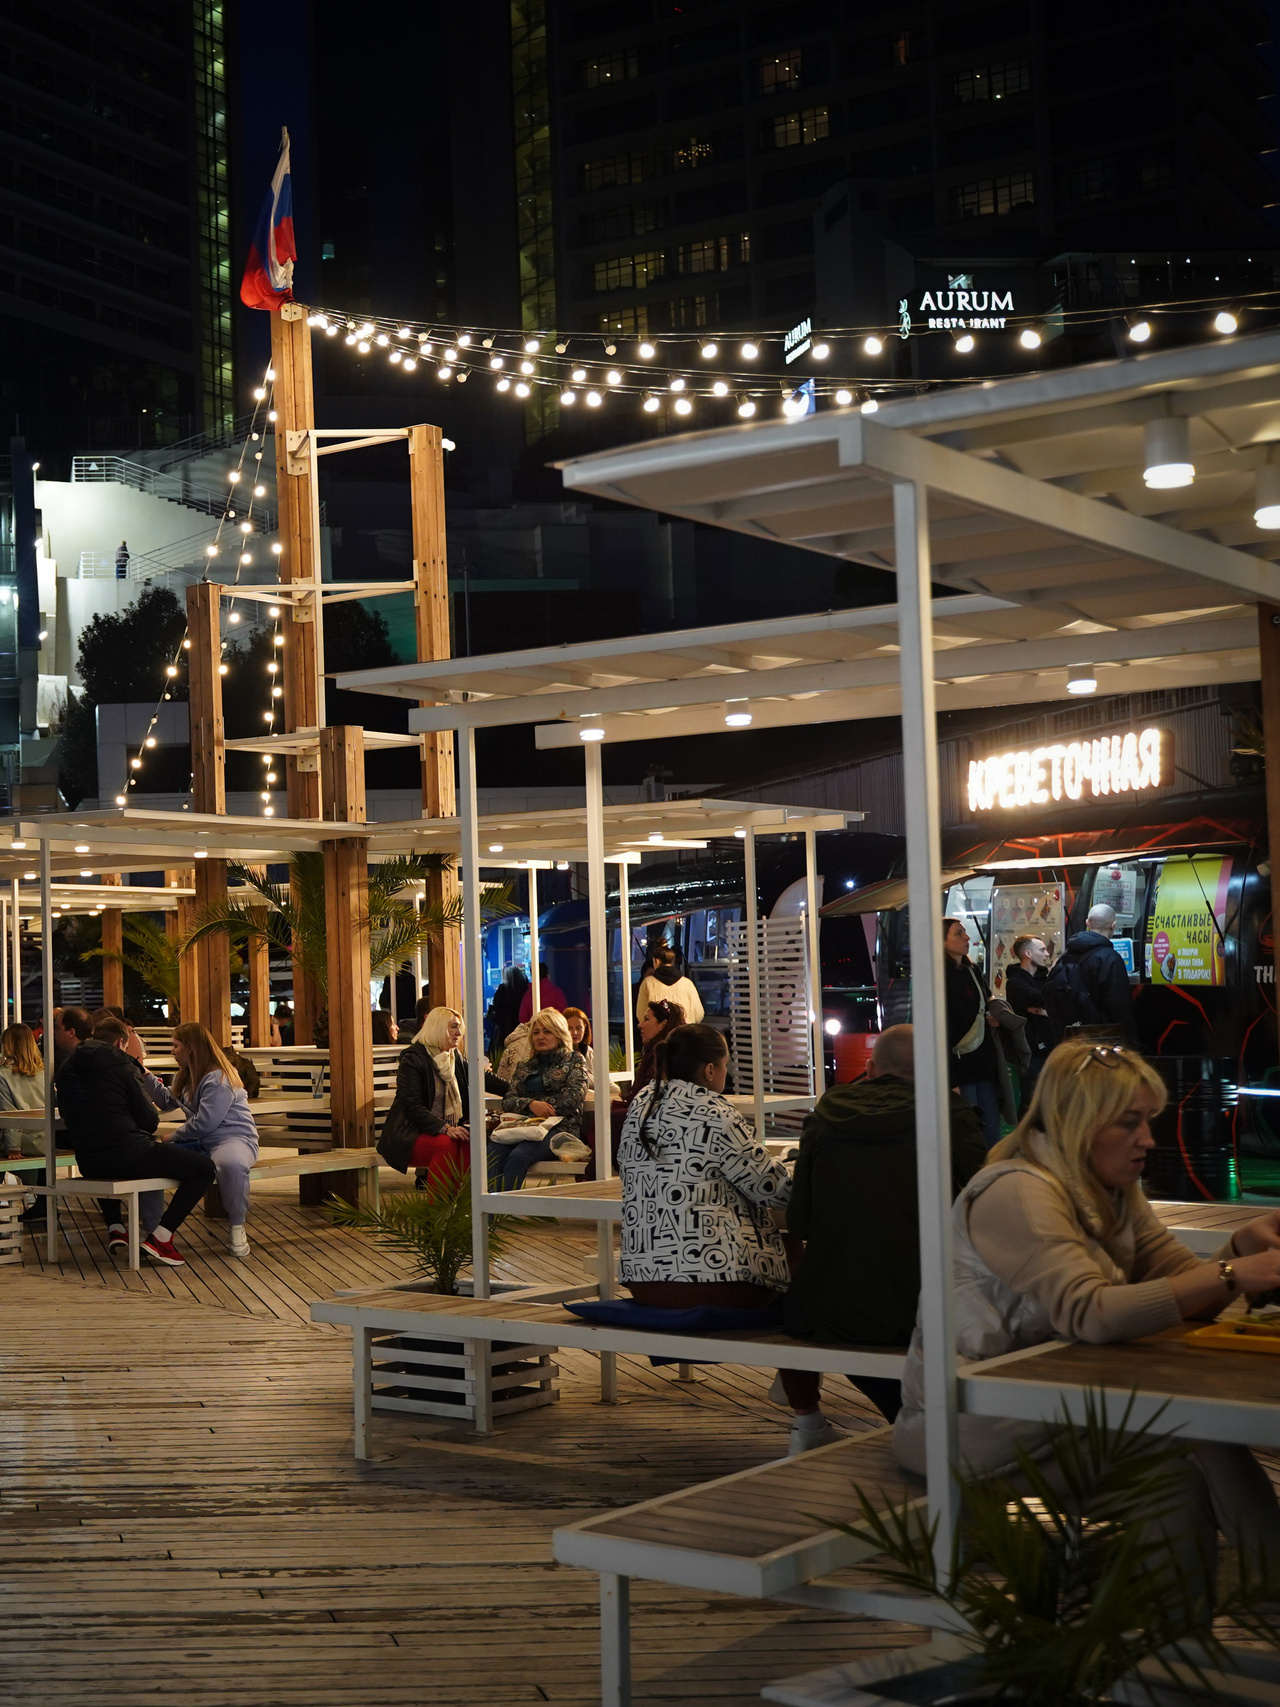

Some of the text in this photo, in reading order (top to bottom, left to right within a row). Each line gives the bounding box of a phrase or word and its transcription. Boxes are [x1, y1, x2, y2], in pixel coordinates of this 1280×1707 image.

[920, 291, 1014, 311] AURUM
[967, 728, 1161, 812] КРЕВЕТОЧНАЯ
[1154, 912, 1212, 929] СЧАСТЛИВЫЕ
[1186, 930, 1211, 944] ЧАСЫ
[1253, 965, 1277, 984] TH
